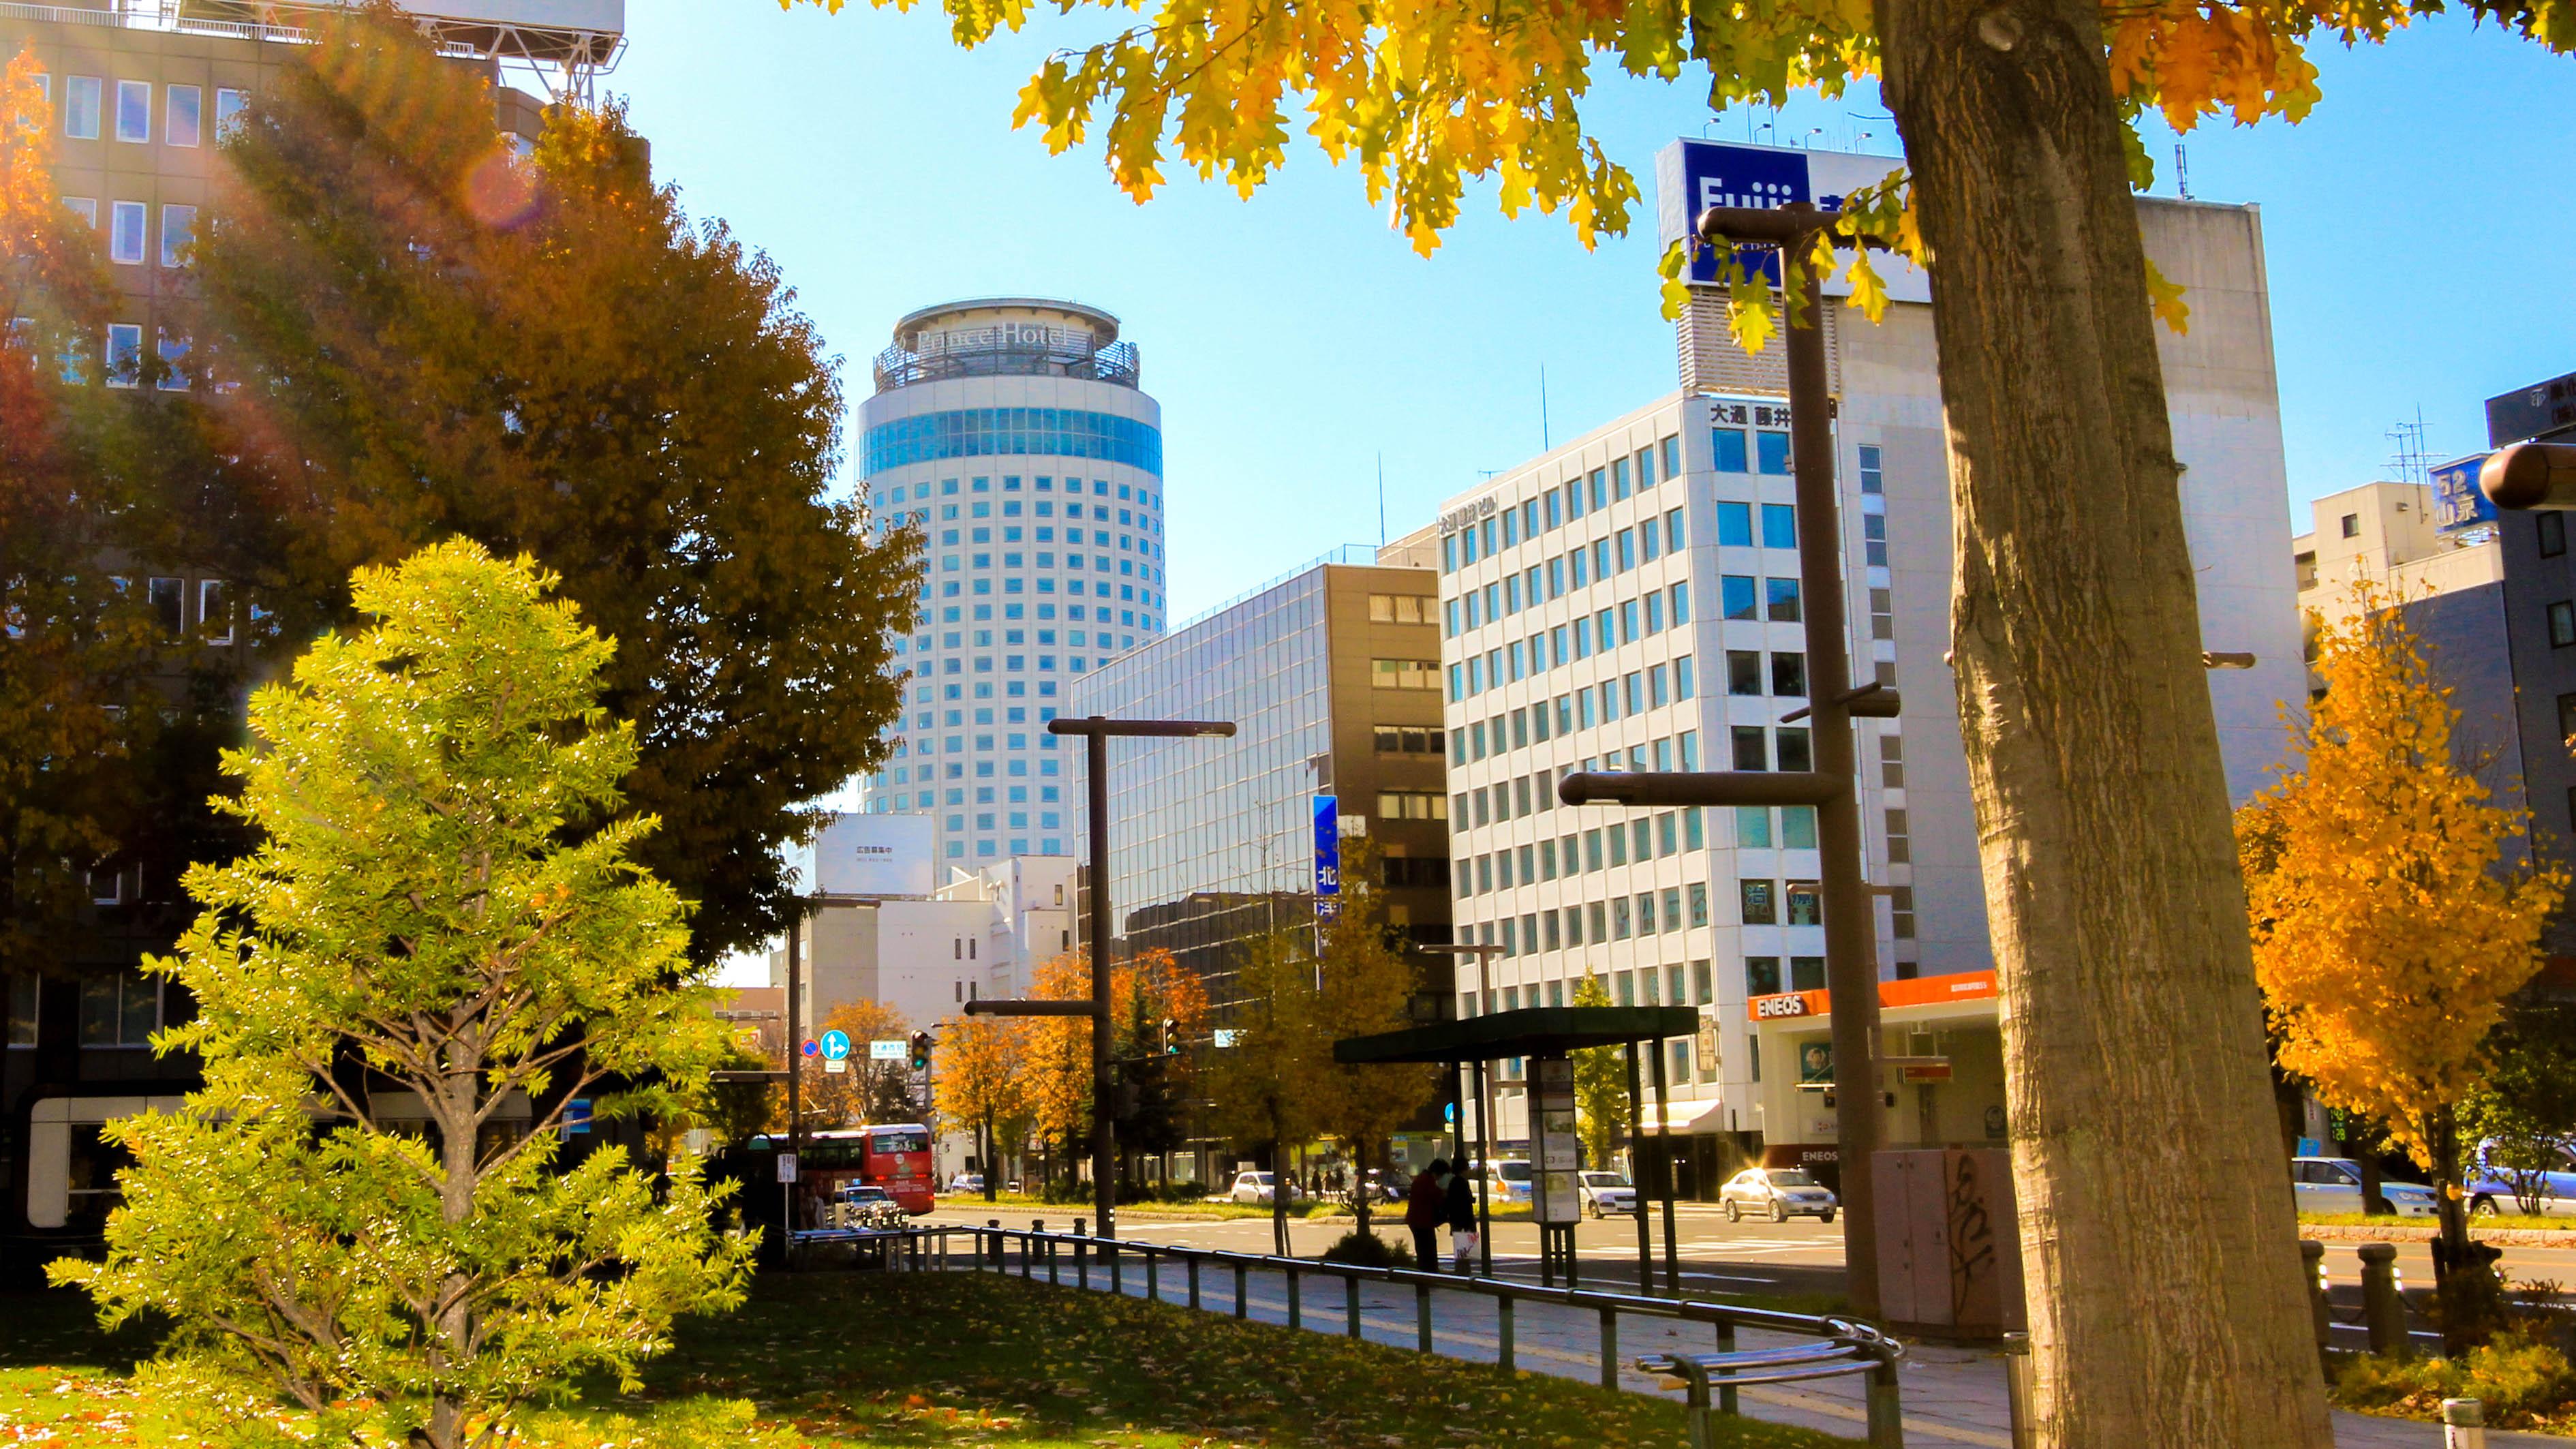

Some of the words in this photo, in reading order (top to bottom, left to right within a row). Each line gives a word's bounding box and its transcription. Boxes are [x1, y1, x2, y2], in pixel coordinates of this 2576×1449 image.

[917, 330, 991, 352] Prince
[1002, 321, 1068, 345] Hotel
[2437, 469, 2467, 497] 52
[2436, 494, 2479, 527] 山京
[1758, 995, 1803, 1017] ENEOS
[1802, 1151, 1838, 1161] ENEOS
